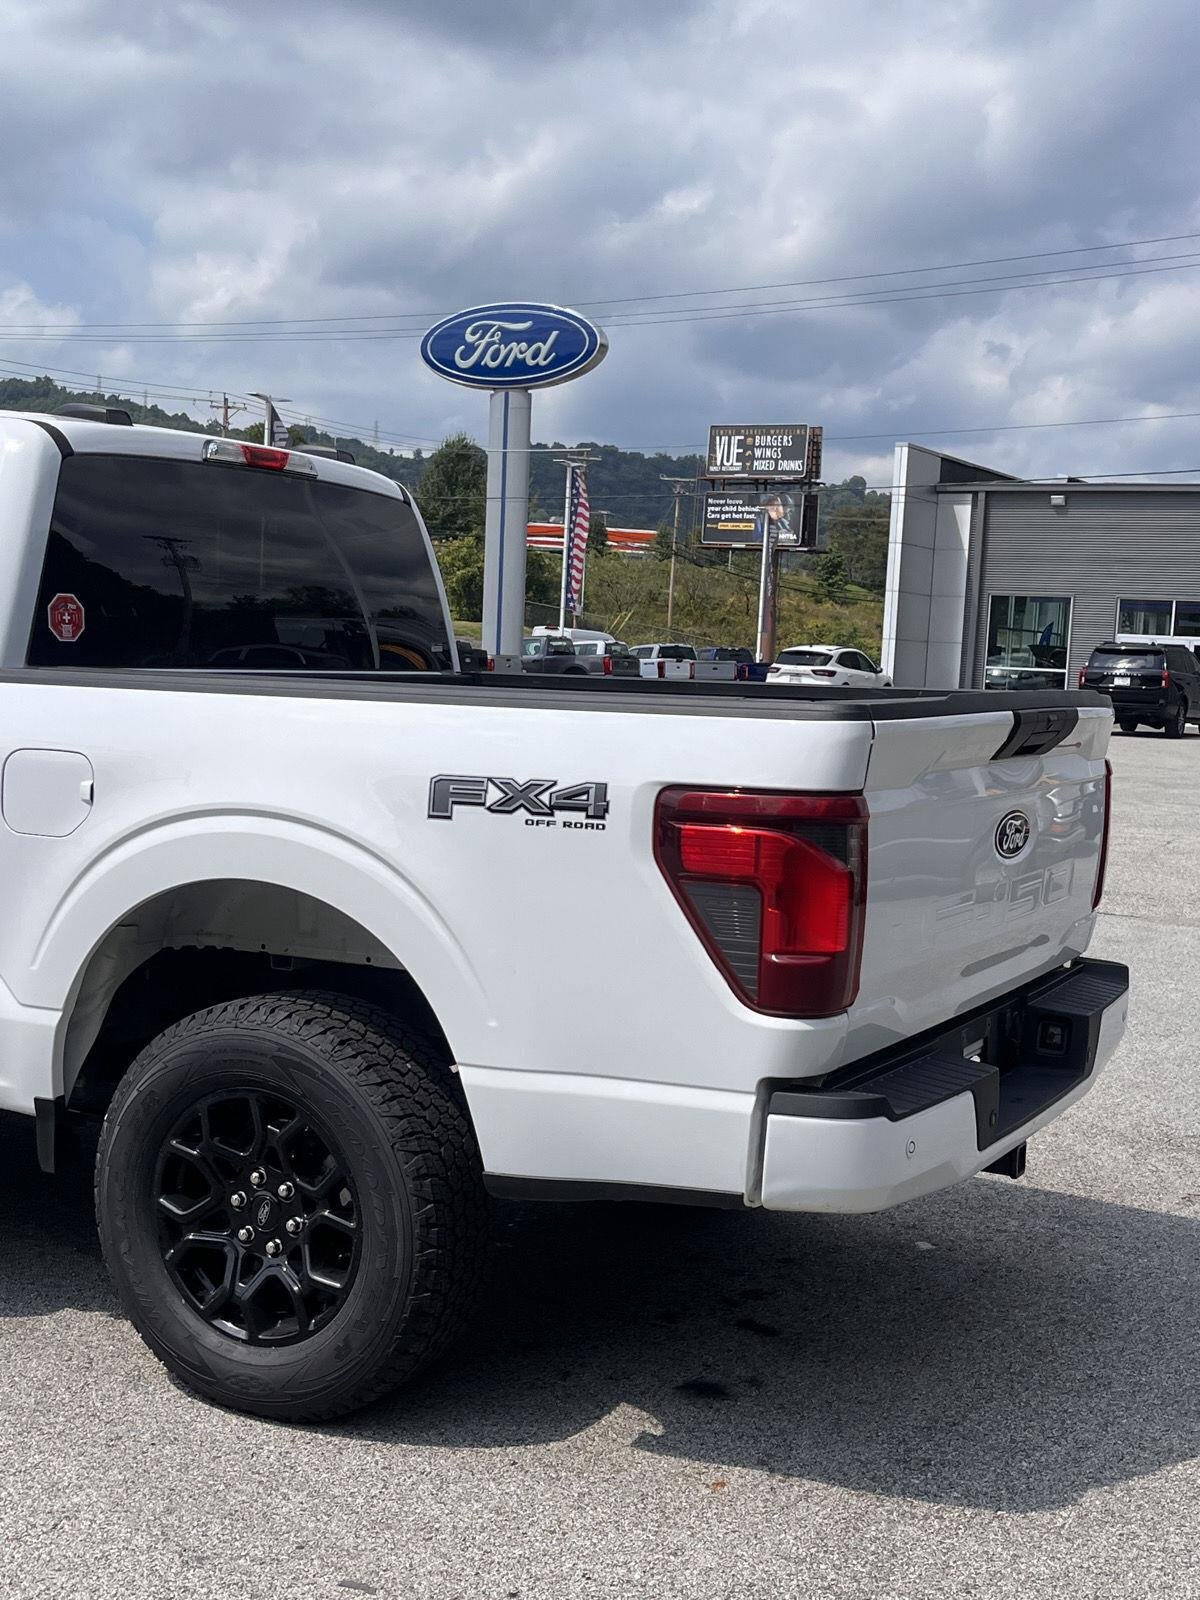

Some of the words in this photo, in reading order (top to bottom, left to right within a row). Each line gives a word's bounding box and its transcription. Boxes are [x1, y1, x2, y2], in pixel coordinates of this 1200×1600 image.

[454, 320, 560, 369] Ford
[715, 435, 745, 466] VUE
[754, 435, 793, 447] BURGERS
[753, 447, 782, 459] WINGS
[752, 459, 775, 471] MIXED
[777, 459, 803, 471] DRINKS
[427, 774, 610, 820] FX4
[524, 818, 557, 827] OFF
[562, 820, 607, 831] ROAD
[1002, 819, 1026, 850] Ford
